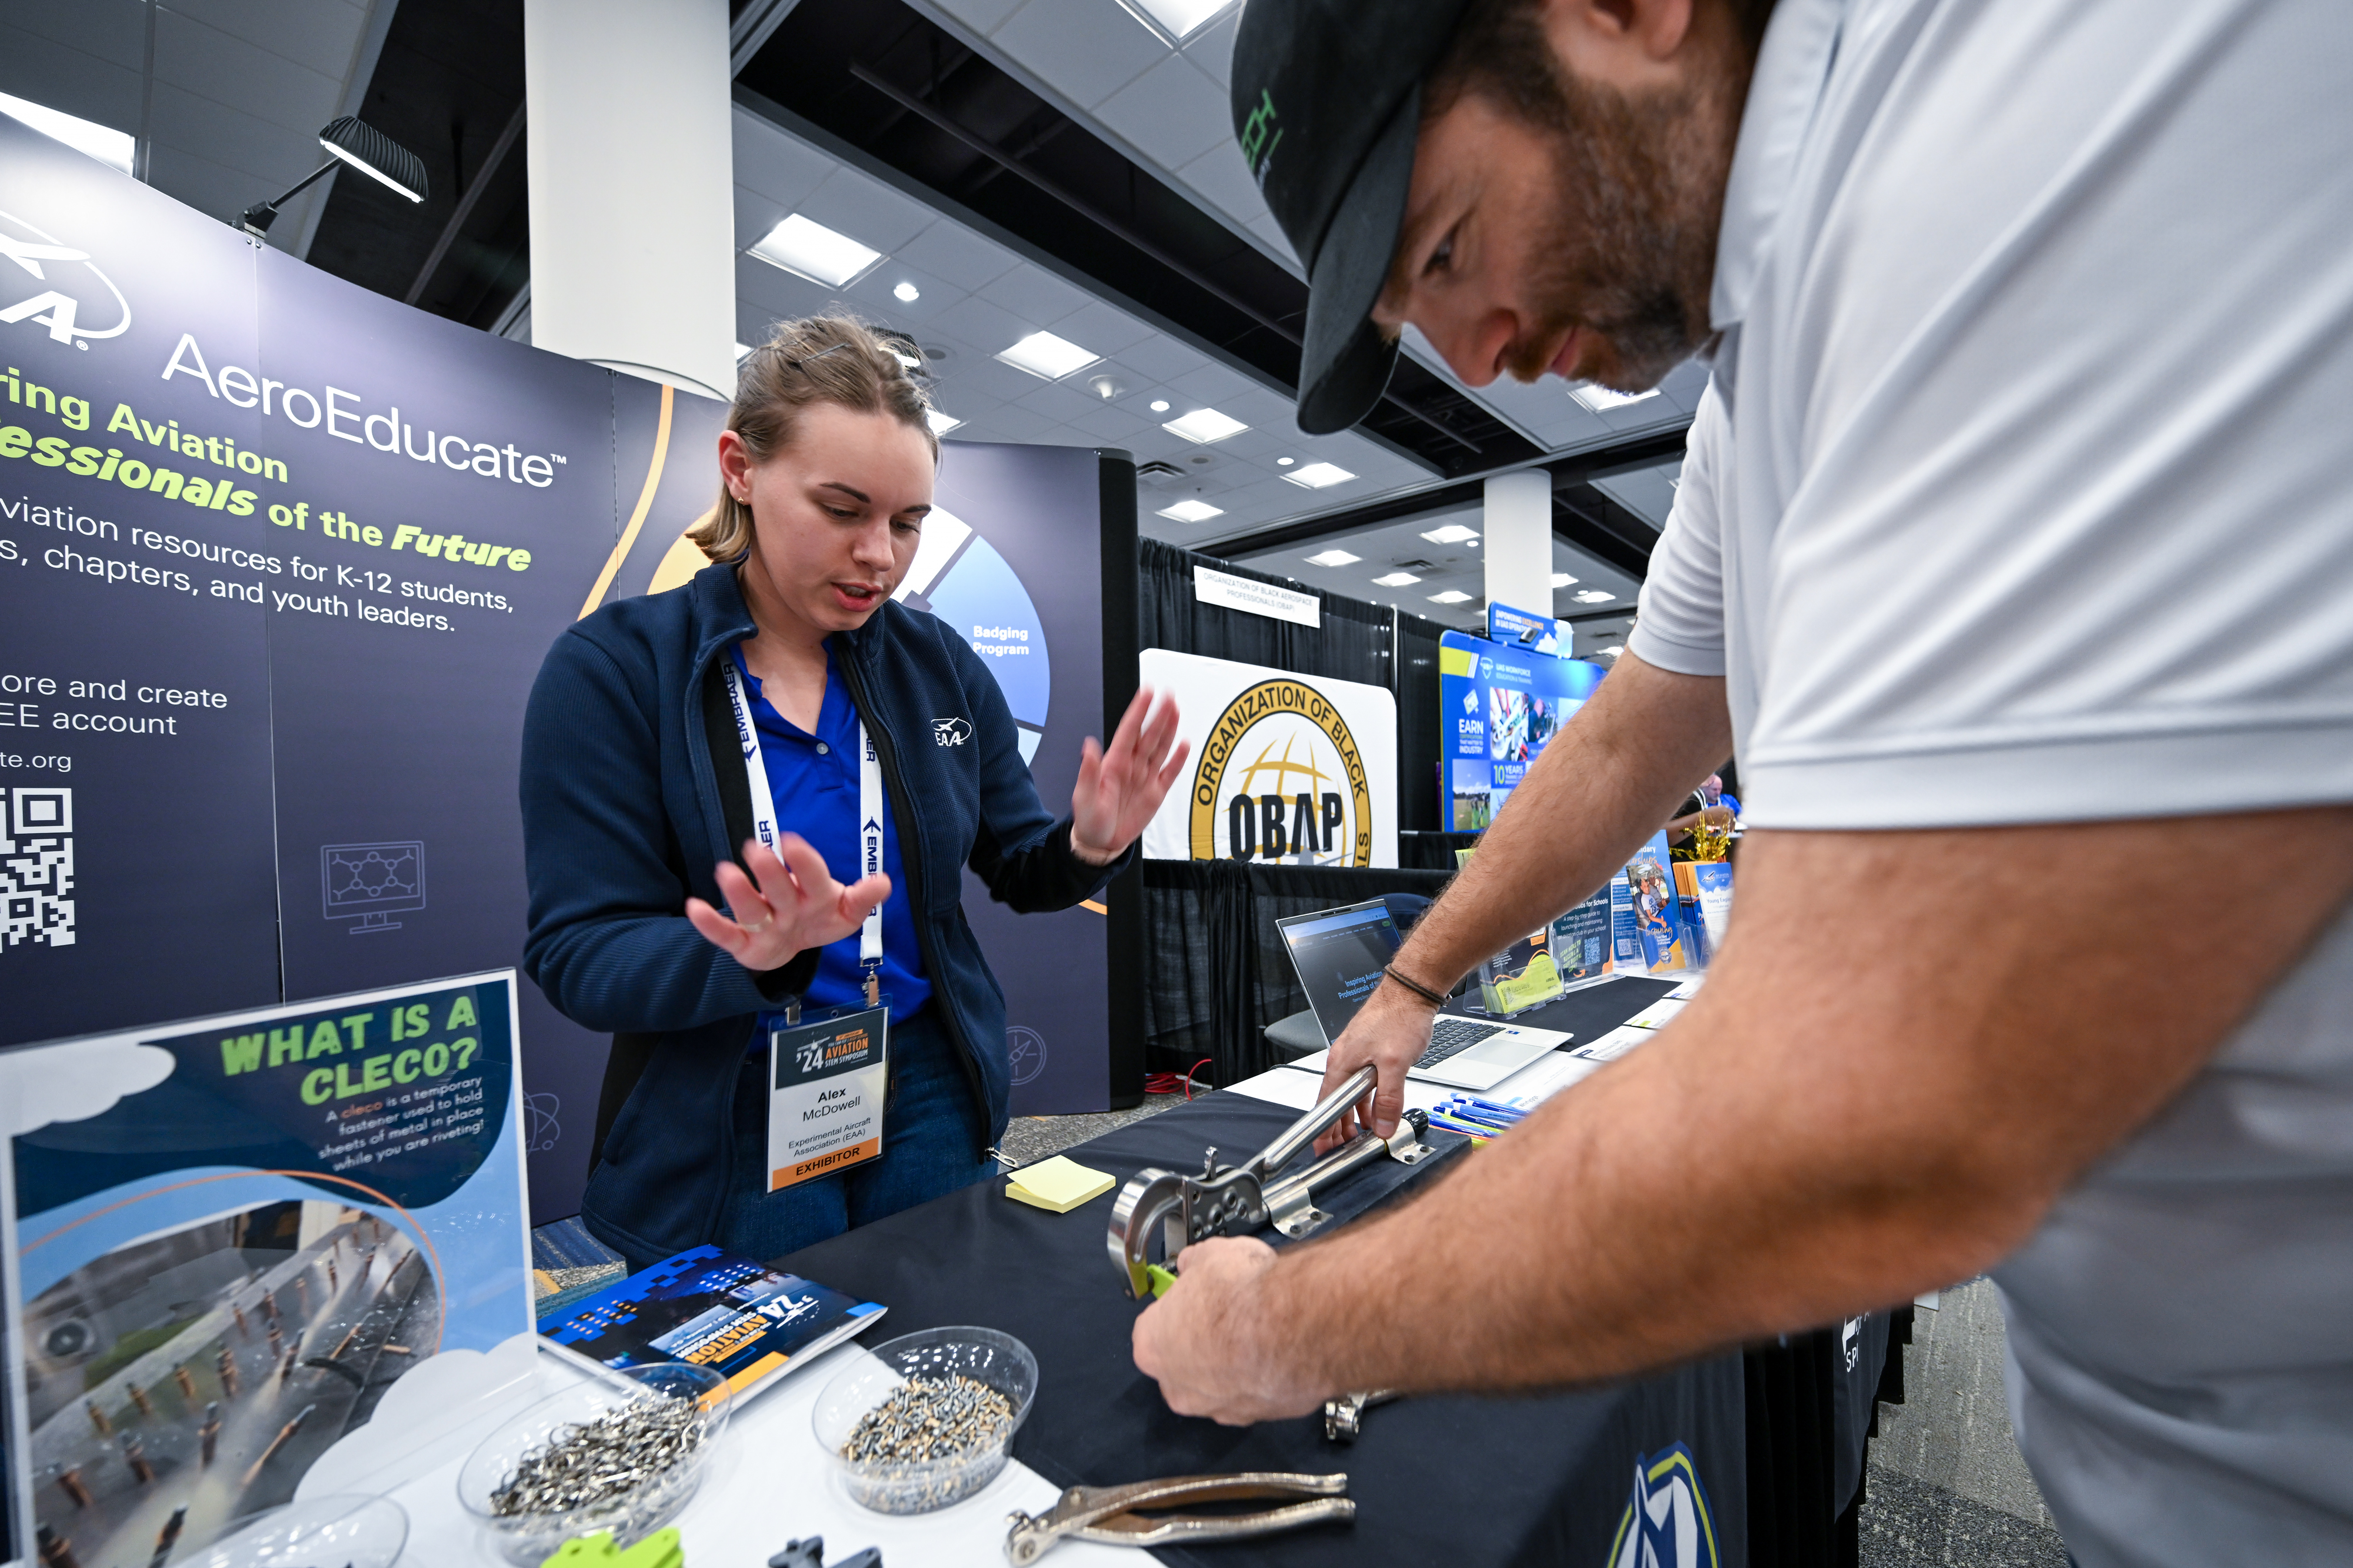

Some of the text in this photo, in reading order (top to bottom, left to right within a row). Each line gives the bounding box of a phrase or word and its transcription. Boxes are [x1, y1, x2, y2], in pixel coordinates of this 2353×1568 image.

[107, 403, 288, 483] Aviation
[269, 502, 308, 532] of
[319, 512, 383, 547] the
[391, 525, 532, 572] Future
[132, 528, 282, 574] resources
[290, 556, 328, 582] for
[337, 565, 392, 594] K-12
[401, 581, 513, 613] students,
[45, 545, 199, 595] chapters,
[210, 577, 264, 605] and
[272, 590, 348, 618] youth
[358, 599, 455, 631] leaders.
[1204, 572, 1250, 590] ORGANIZATION
[1261, 587, 1279, 596] BLACK
[1281, 590, 1312, 606] AEROSPACE
[1227, 589, 1294, 613] PROFESSIONALS (OBAP)
[974, 625, 1028, 641] Badging
[973, 642, 1029, 657] Program
[69, 679, 126, 701] and
[137, 685, 228, 709] create
[724, 663, 750, 743] EMBRAER
[52, 710, 177, 735] account
[1310, 698, 1331, 724] OF
[935, 731, 961, 746] EAA
[1459, 719, 1484, 734] EARN
[1197, 686, 1305, 806] ORGANIZATION
[1331, 721, 1367, 799] BLACK
[1459, 745, 1484, 754] INDUSTRY
[1494, 765, 1505, 784] 10
[1505, 765, 1523, 774] YEARS
[1229, 793, 1344, 862] OBAP
[1561, 922, 1577, 931] launching
[1567, 913, 1587, 922] step-by-step
[1563, 931, 1576, 939] aviation
[1338, 985, 1369, 1000] Professionals
[1369, 981, 1375, 989] of
[1345, 970, 1383, 987] Inspiring Aviation
[220, 996, 477, 1076] WHAT IS A
[825, 1037, 868, 1060] AVIATION
[300, 1037, 478, 1105] CLECO?
[825, 1057, 838, 1068] STEM
[839, 1049, 868, 1064] SYMPOSIUM
[325, 1076, 482, 1123] A cleco is a temporary
[803, 1096, 861, 1122] McDowell
[818, 1087, 846, 1103] Alex
[339, 1087, 482, 1136] fastener used to hold
[318, 1106, 484, 1159] sheets of metal in place
[332, 1119, 484, 1172] while you are riveting!
[789, 1117, 871, 1149] Experimental Aircraft
[794, 1128, 865, 1157] Association (EAA)
[796, 1147, 859, 1176] EXHIBITOR
[685, 1315, 768, 1364] AVIATION
